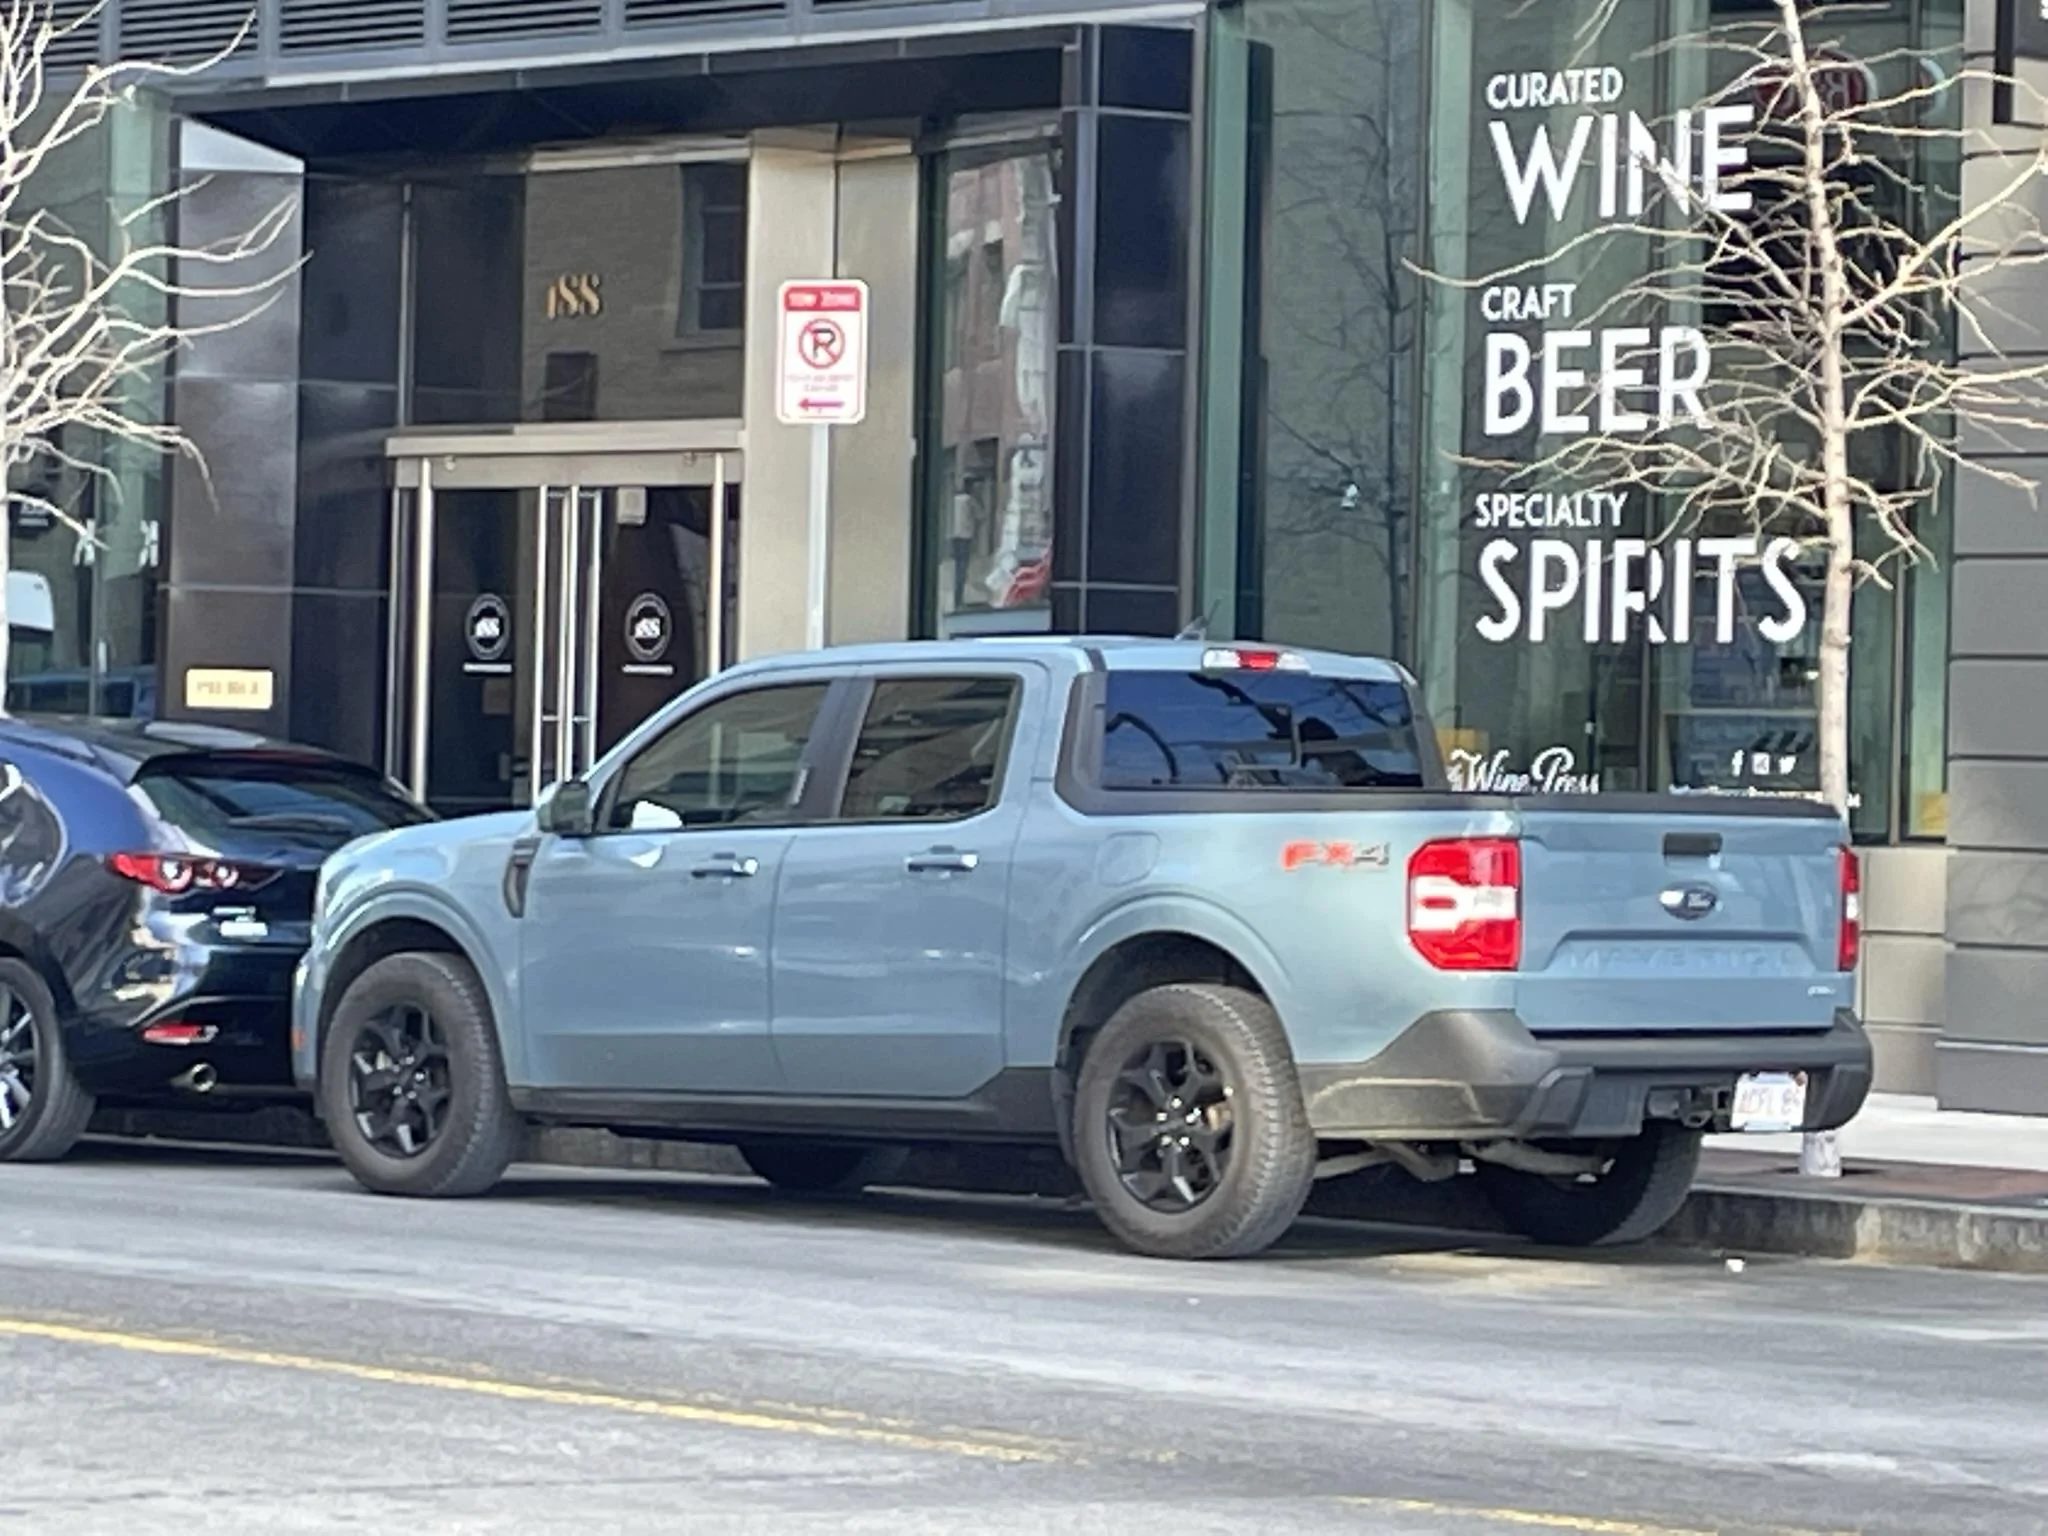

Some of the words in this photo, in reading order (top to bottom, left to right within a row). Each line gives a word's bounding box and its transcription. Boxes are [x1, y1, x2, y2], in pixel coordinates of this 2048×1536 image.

[1487, 67, 1624, 110] CURATED
[1489, 104, 1755, 224] WINE
[1481, 283, 1577, 321] CRAFT
[1484, 326, 1714, 436] BEER
[1475, 492, 1628, 528] SPECIALTY
[1476, 537, 1807, 643] SPIRITS
[1451, 749, 1531, 793] Wine
